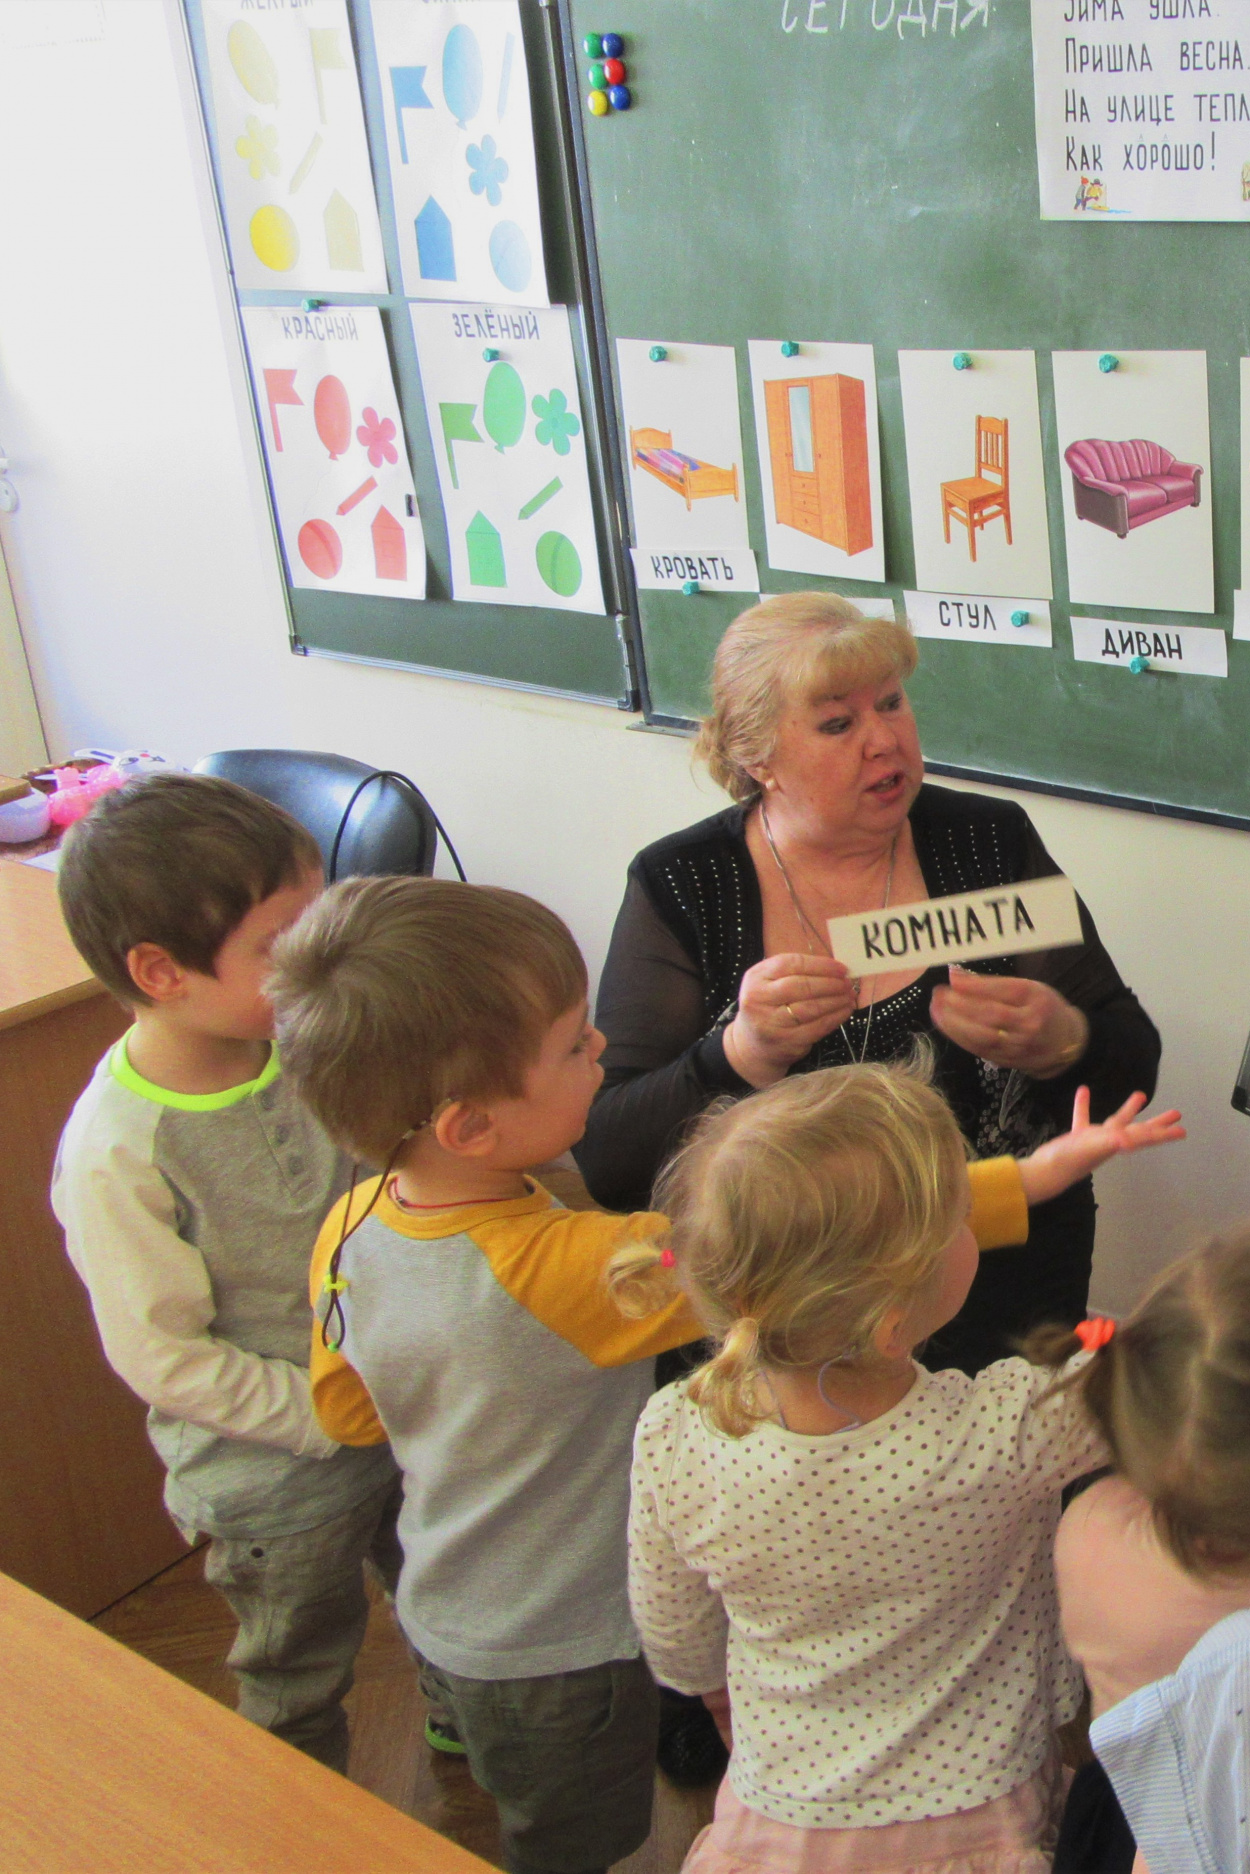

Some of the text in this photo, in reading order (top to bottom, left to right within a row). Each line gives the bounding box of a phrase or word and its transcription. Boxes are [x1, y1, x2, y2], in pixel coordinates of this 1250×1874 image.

[1107, 94, 1175, 126] УЛИЦЕ
[281, 314, 359, 341] КРАСНЫЙ
[452, 309, 541, 341] ЗЕЛЁНЫЙ
[651, 555, 734, 581] КРОВАТЬ
[939, 600, 997, 631] СТУЛ
[1101, 628, 1183, 660] ДИВАН
[861, 893, 1036, 959] КОМНАТА
